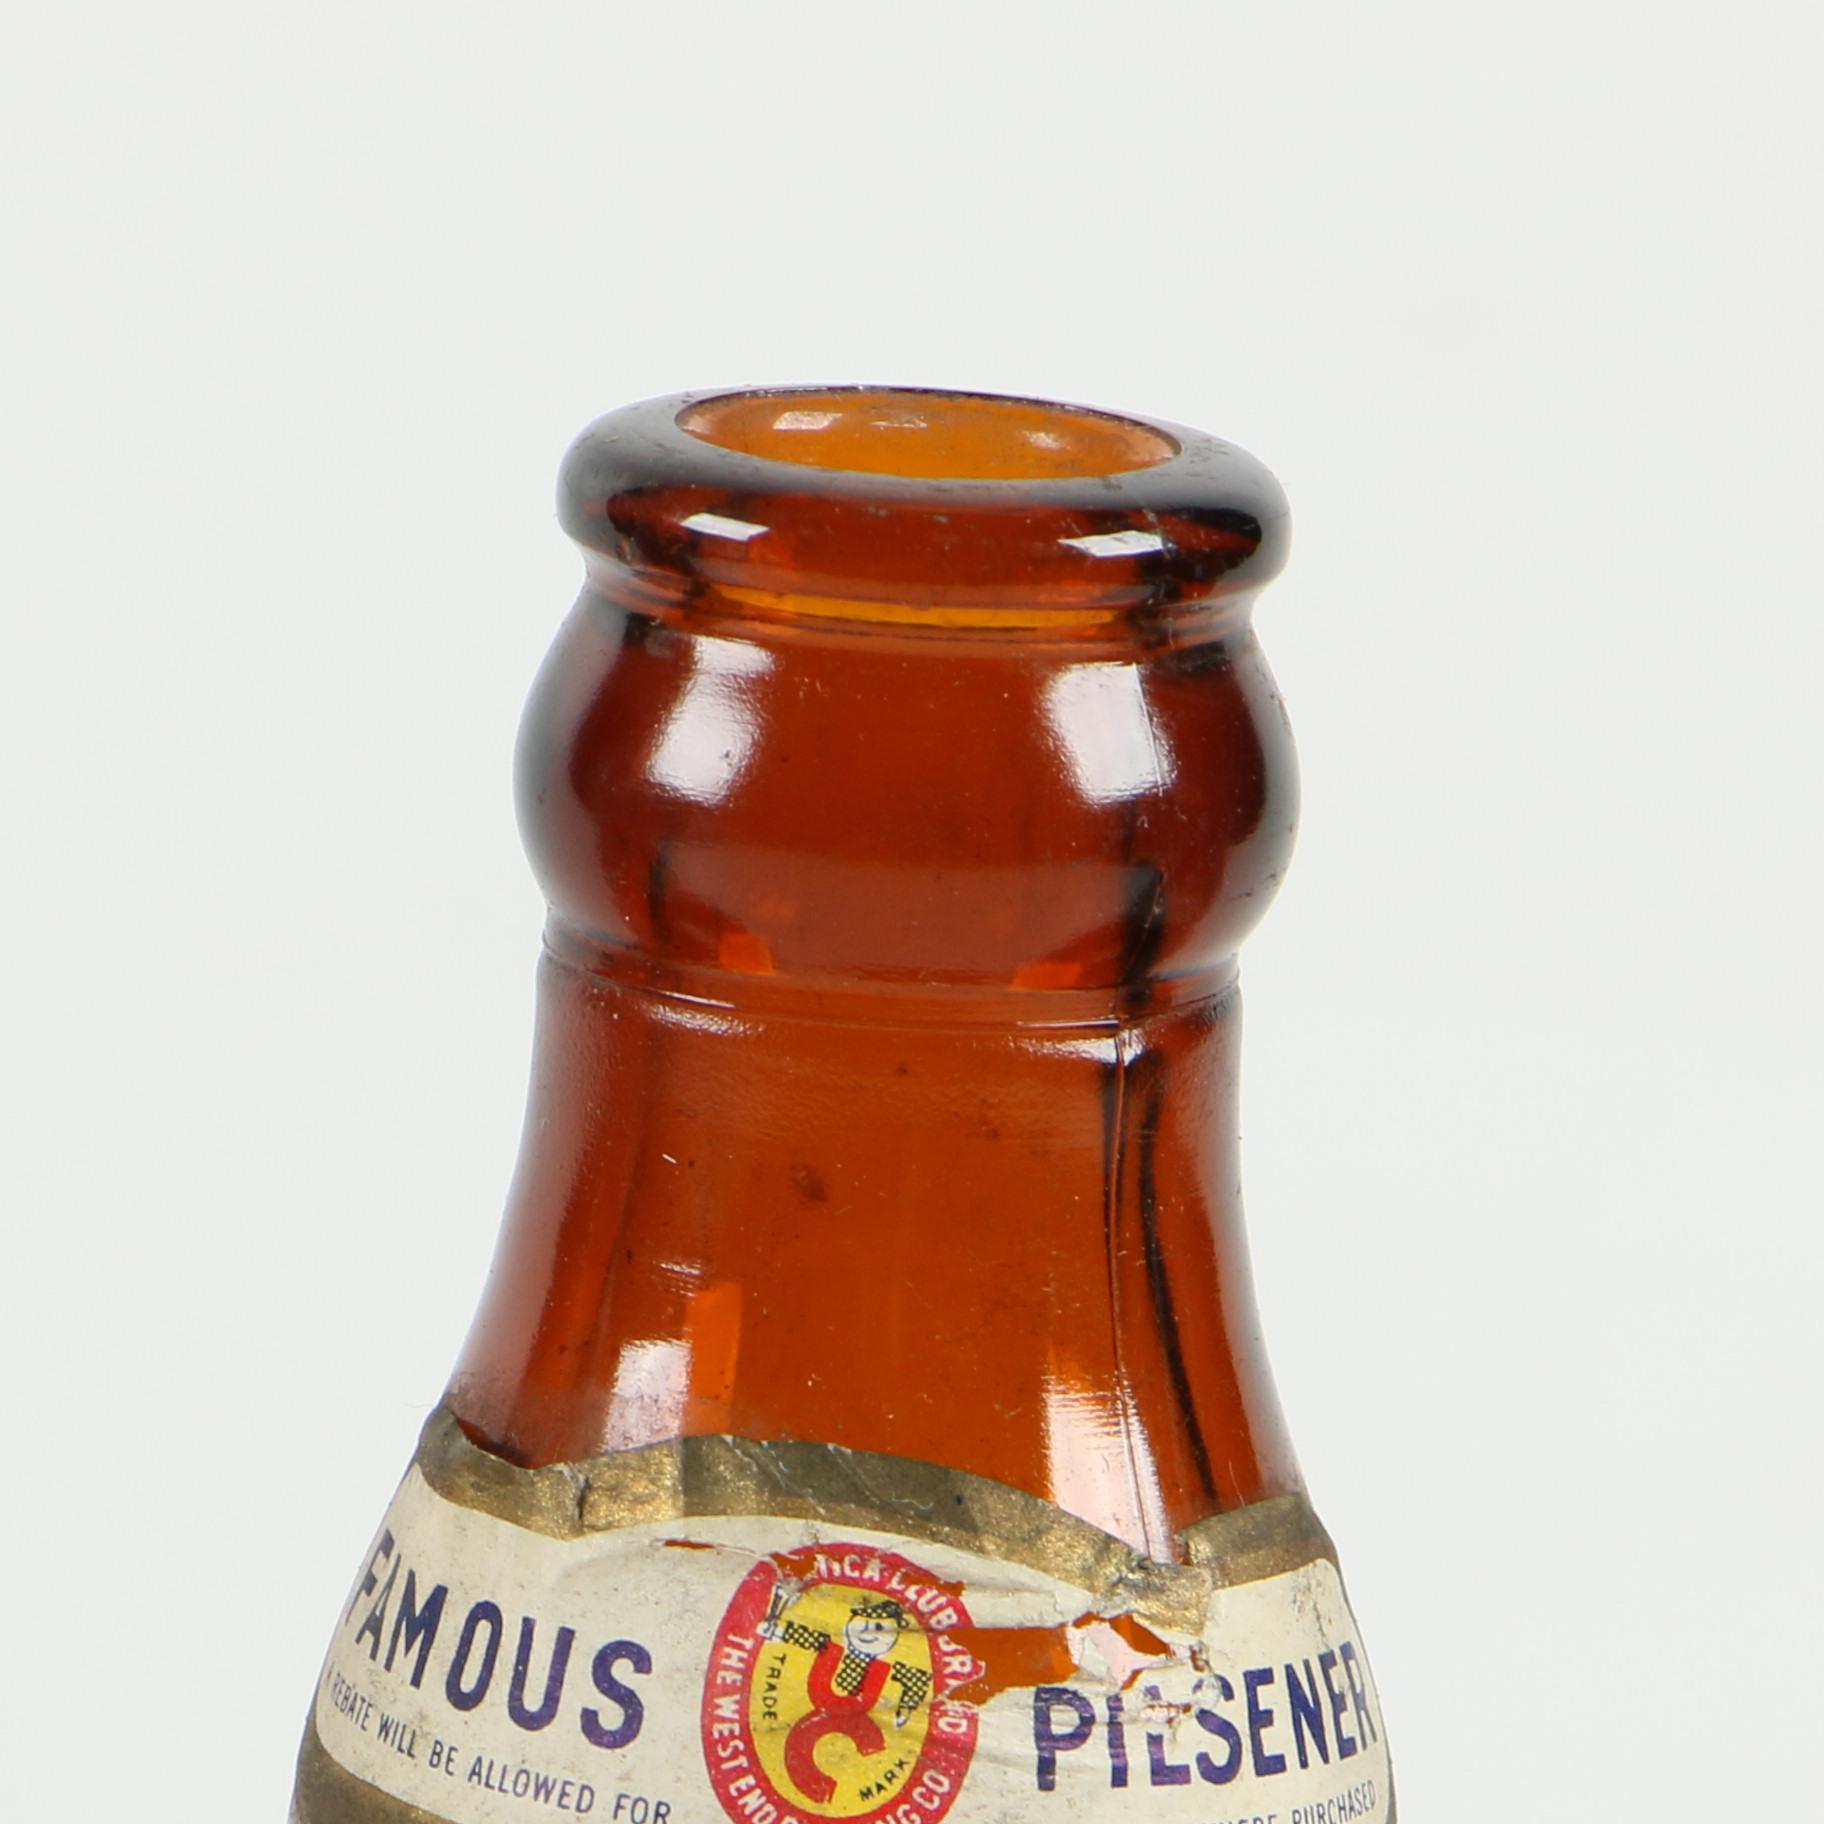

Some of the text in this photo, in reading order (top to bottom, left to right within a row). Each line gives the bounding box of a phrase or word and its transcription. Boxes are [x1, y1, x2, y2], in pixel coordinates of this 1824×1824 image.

[345, 1527, 653, 1750] FAMOUS
[716, 1634, 755, 1685] THE
[762, 1654, 787, 1721] TRADE
[1034, 1641, 1377, 1792] PILSENER
[330, 1671, 373, 1732] REBATE
[377, 1711, 416, 1759] WILL
[428, 1739, 458, 1776] BE
[468, 1755, 595, 1814] ALLOWED
[713, 1694, 748, 1770] WEST
[859, 1758, 909, 1801] MARK
